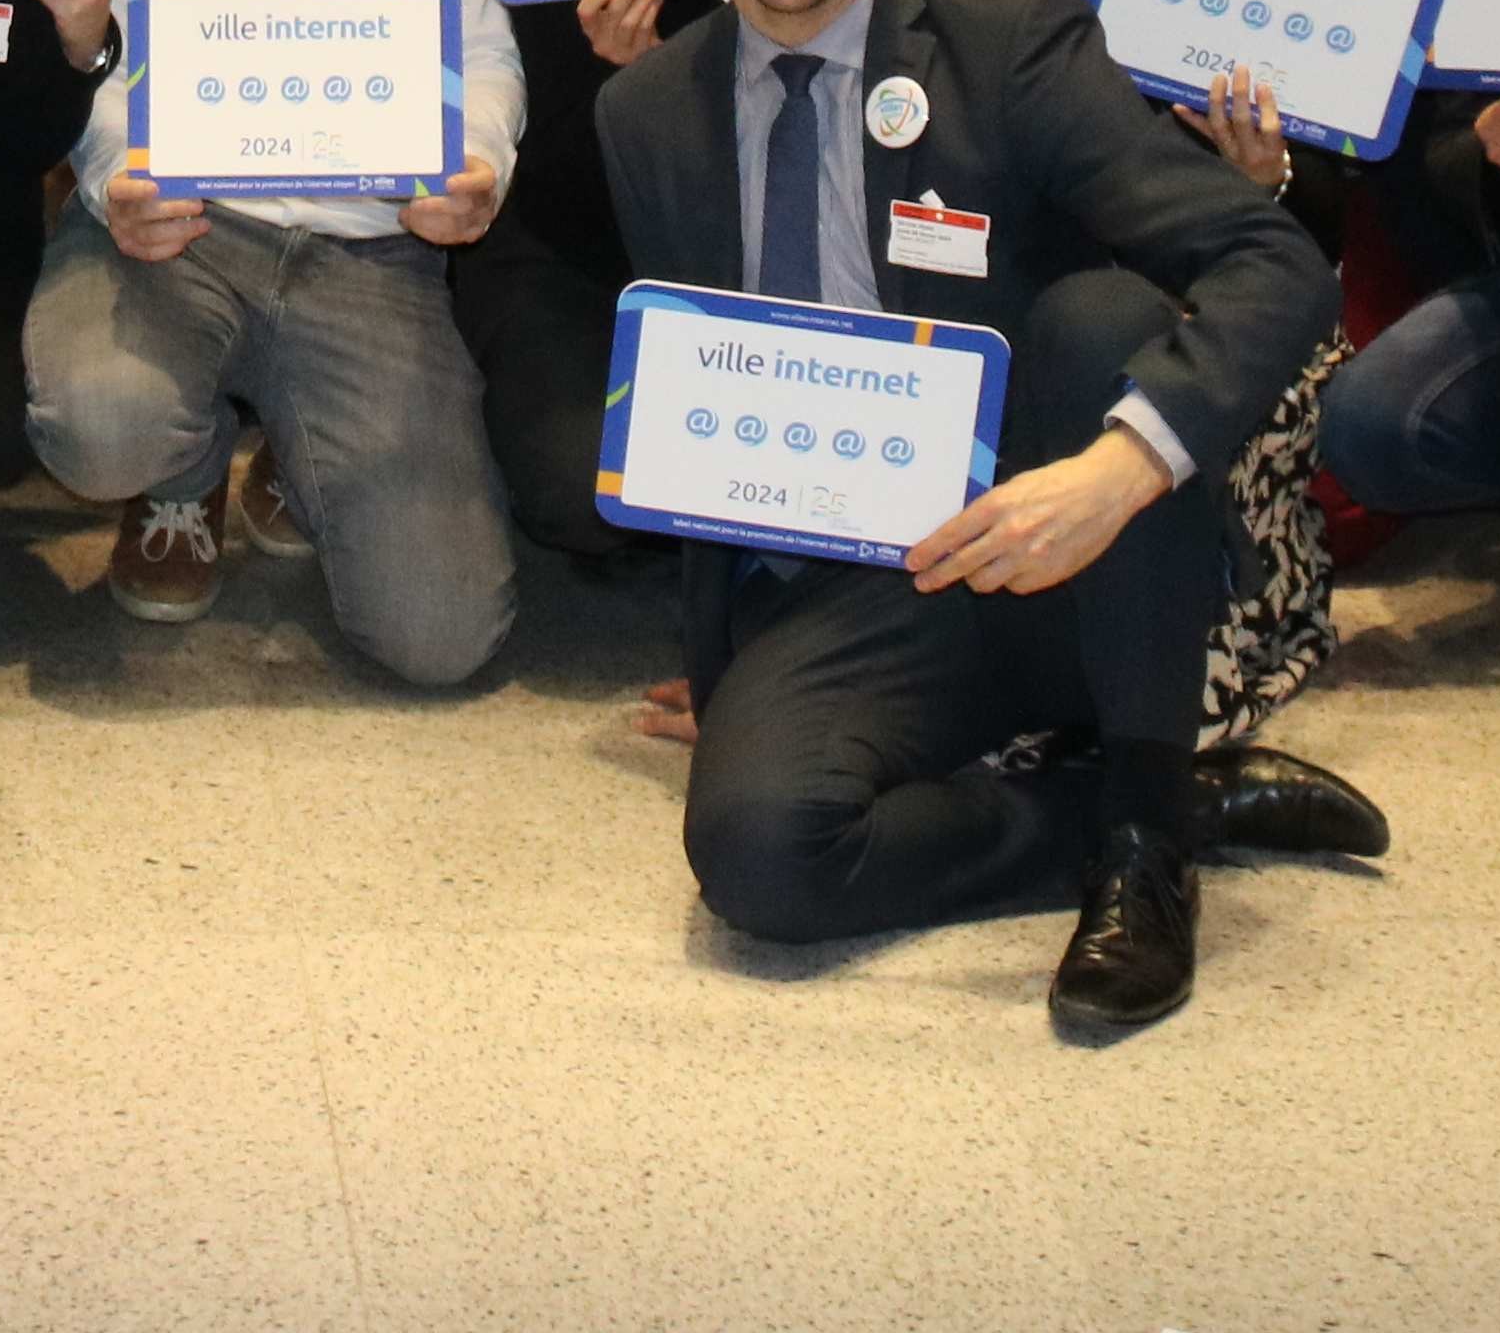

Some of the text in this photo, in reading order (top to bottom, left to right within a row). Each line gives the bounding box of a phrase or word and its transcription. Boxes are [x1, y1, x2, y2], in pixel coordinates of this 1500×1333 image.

[199, 12, 391, 41] ville internet
[1181, 45, 1237, 76] 2024
[240, 137, 292, 156] 2024
[697, 341, 922, 400] ville internet
[726, 479, 788, 507] 2024
